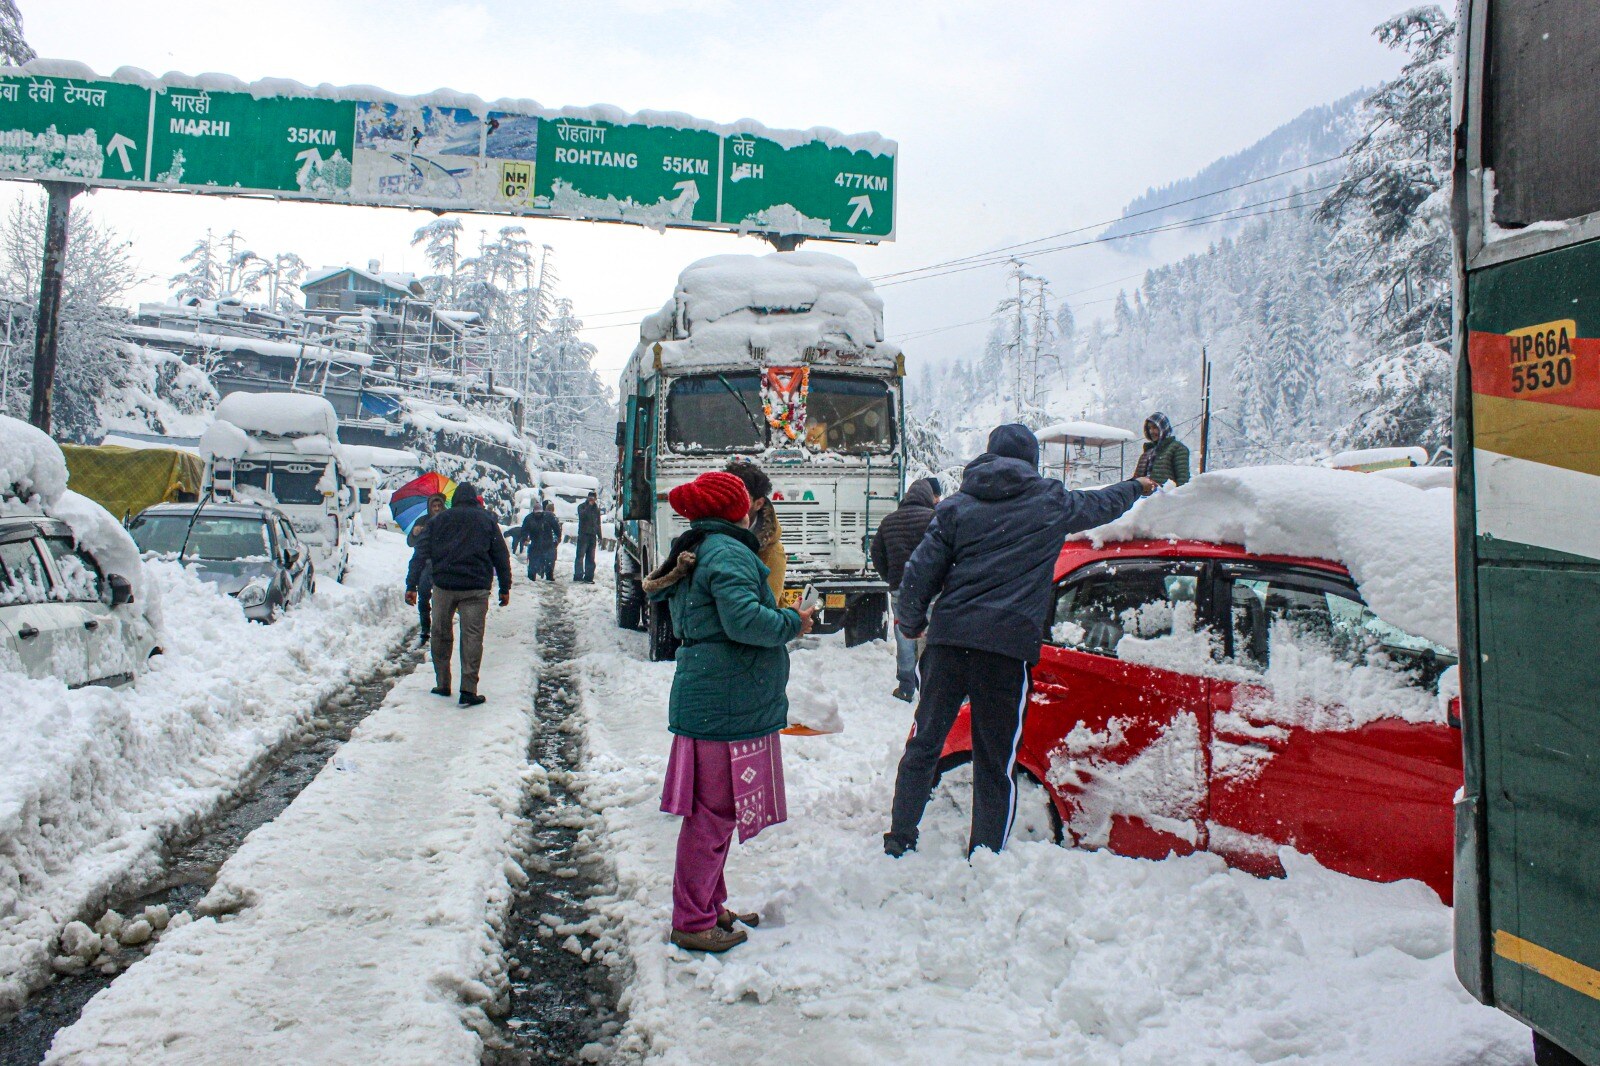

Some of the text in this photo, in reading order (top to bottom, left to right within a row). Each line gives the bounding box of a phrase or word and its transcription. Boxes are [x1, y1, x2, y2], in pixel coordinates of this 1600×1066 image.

[28, 77, 56, 103] देवी
[63, 80, 107, 107] टेम्पल
[170, 118, 230, 137] MARHI
[287, 127, 336, 146] 35KM
[732, 134, 756, 157] लेह
[555, 147, 638, 168] ROHTANG
[662, 156, 709, 175] 55KM
[506, 172, 527, 183] NH
[835, 172, 888, 191] 477KM
[1510, 327, 1571, 363] HP66A
[1511, 357, 1572, 393] 5530
